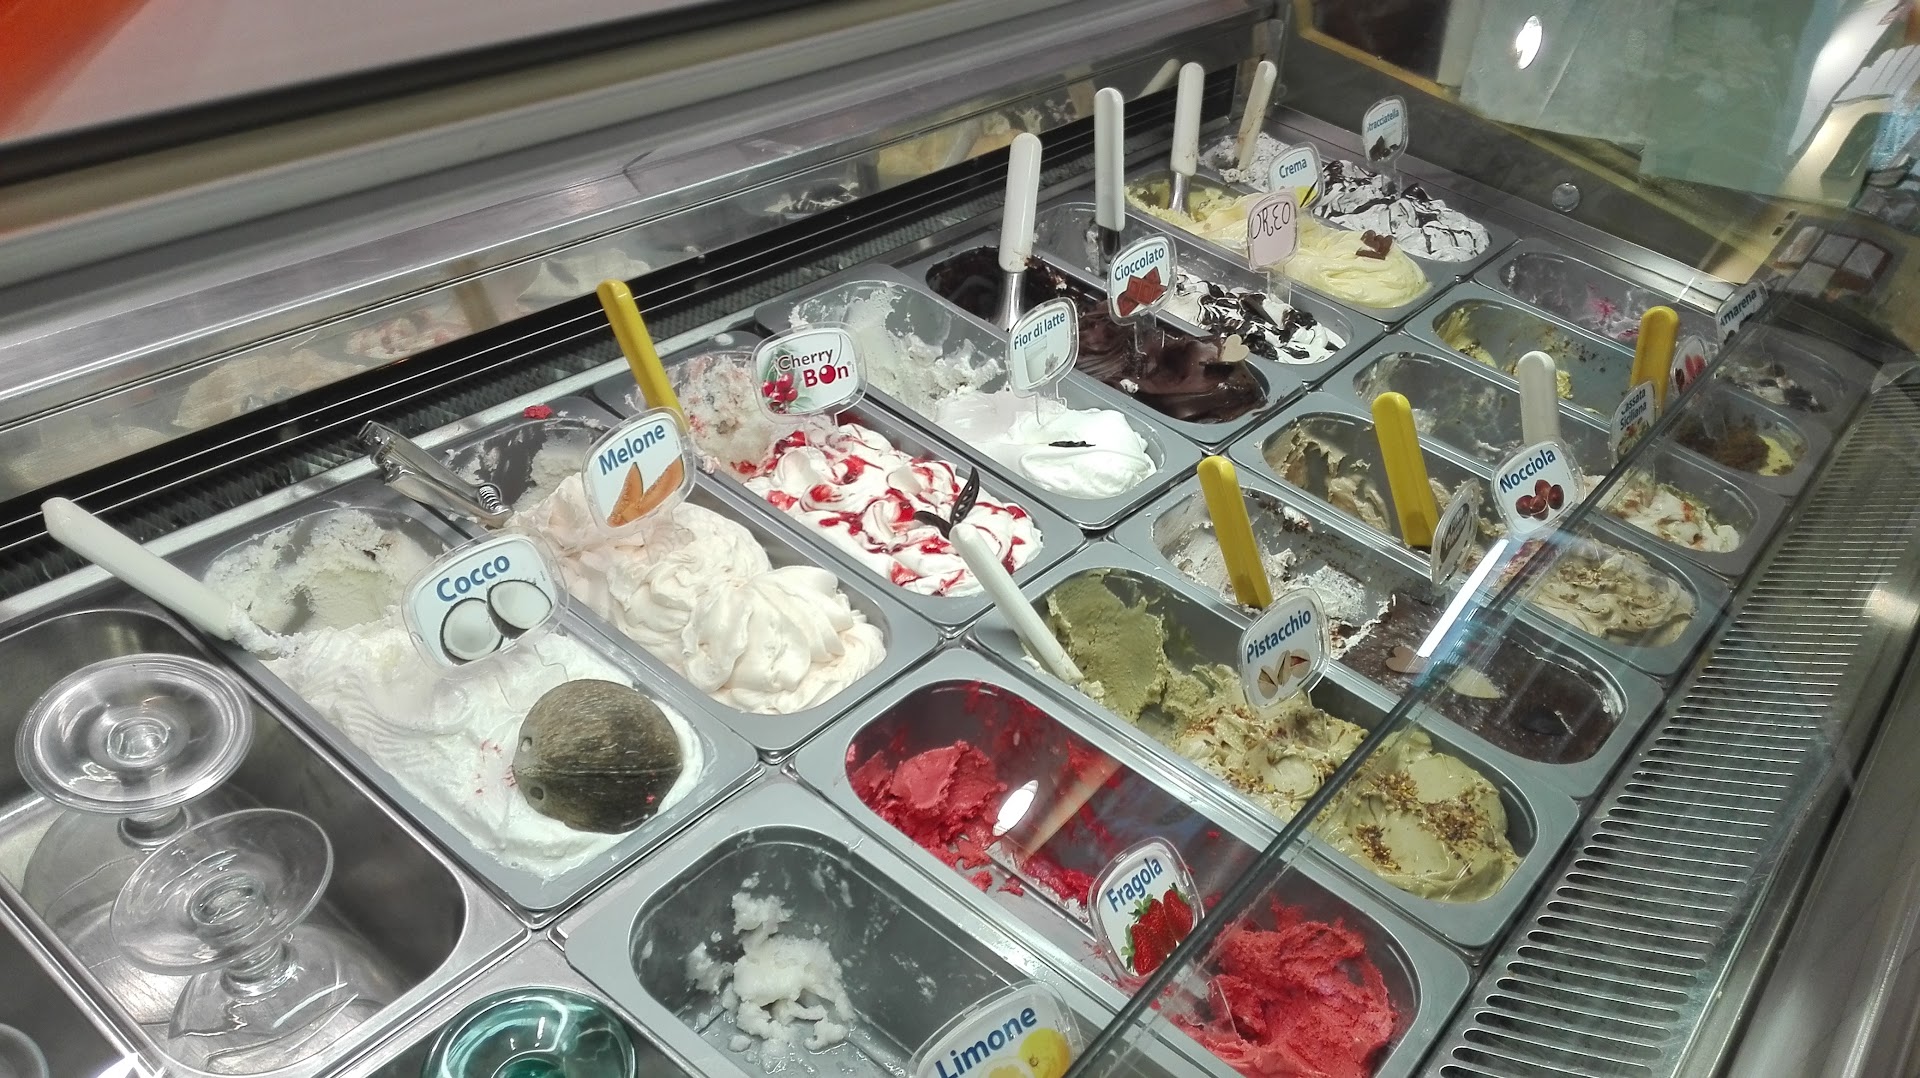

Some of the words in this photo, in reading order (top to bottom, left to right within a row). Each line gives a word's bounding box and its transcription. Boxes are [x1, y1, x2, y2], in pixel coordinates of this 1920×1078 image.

[1279, 157, 1308, 179] Crema
[1114, 246, 1165, 281] Cioccolato
[1013, 331, 1033, 350] Fior
[1033, 320, 1044, 338] di
[1044, 312, 1066, 333] latte
[778, 349, 833, 371] Cherry
[1620, 402, 1647, 431] Siciliana
[598, 424, 665, 476] Melone
[1499, 449, 1556, 493] Nocciola
[436, 555, 510, 602] Cocco
[1246, 609, 1312, 664] Pistacchio
[1106, 857, 1164, 912] Fragola
[934, 1007, 1038, 1078] Limone
